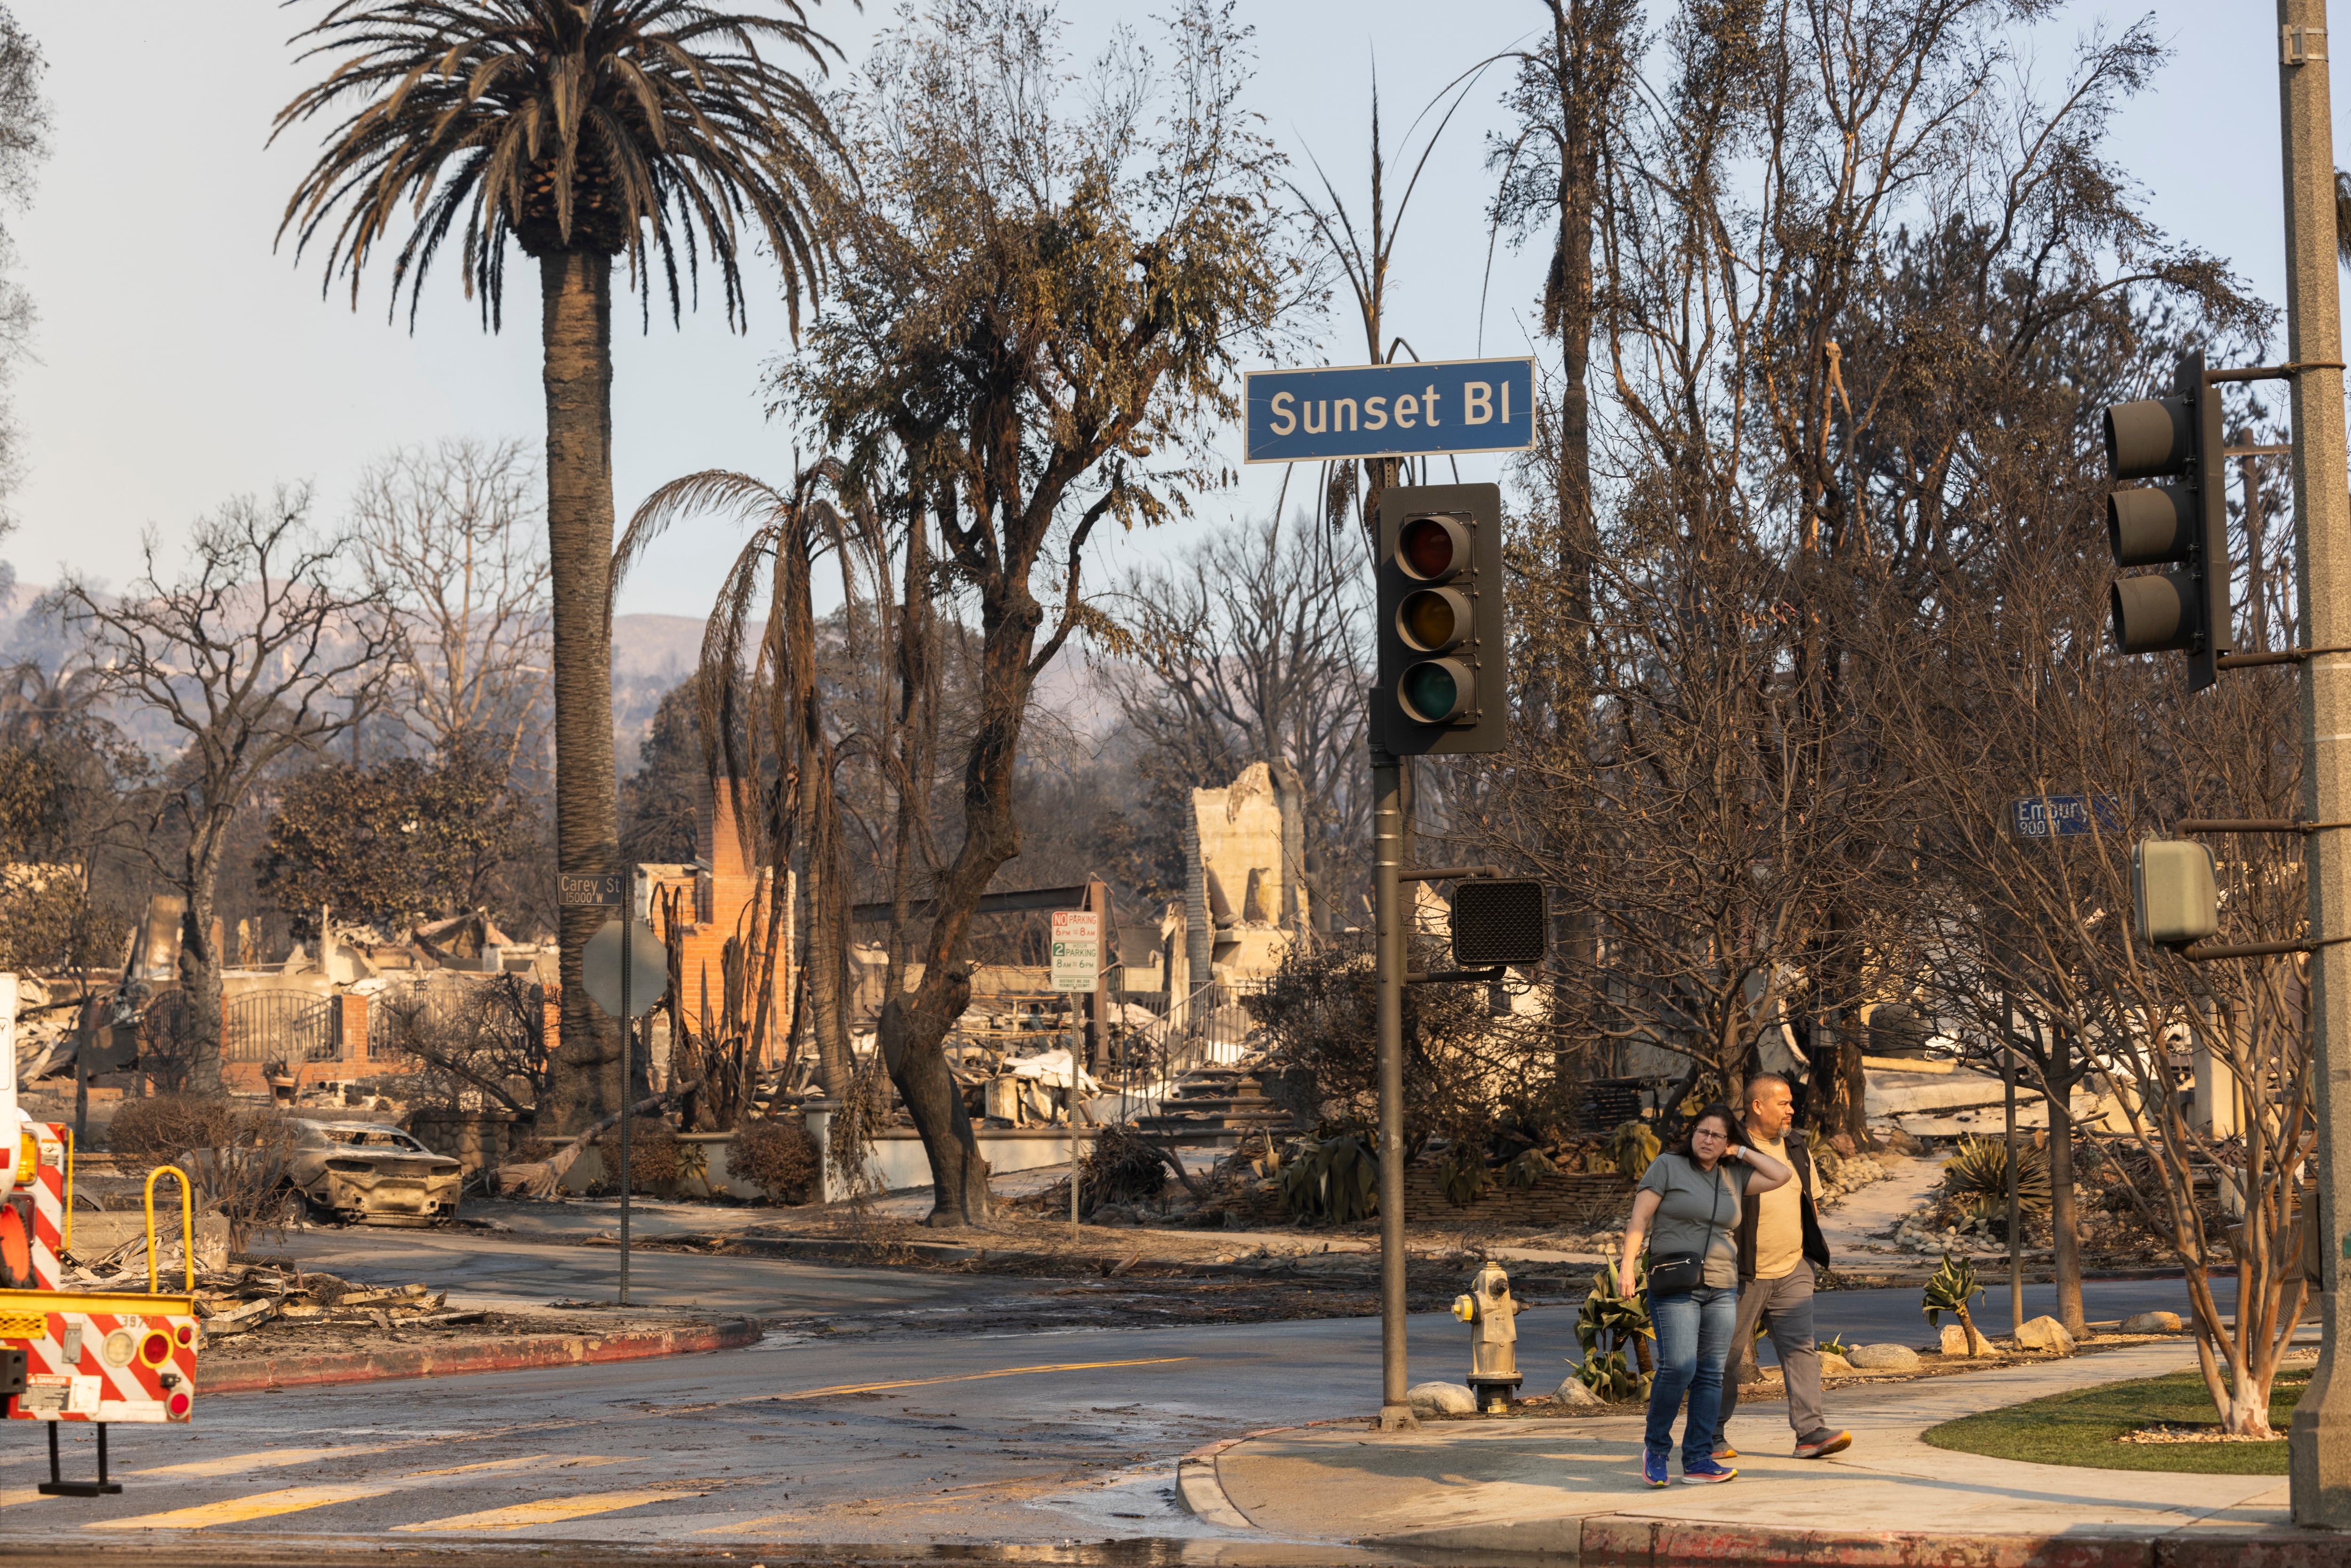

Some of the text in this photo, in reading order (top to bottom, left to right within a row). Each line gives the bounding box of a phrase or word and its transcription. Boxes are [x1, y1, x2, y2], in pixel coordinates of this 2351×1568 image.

[1270, 380, 1510, 436] Sunset Bl
[2020, 820, 2046, 835] 900
[561, 876, 620, 895] Carey St
[566, 892, 603, 903] 15000 W
[1054, 914, 1097, 925] NO PARKING
[1055, 943, 1064, 955] 2
[121, 1315, 157, 1328] 39771
